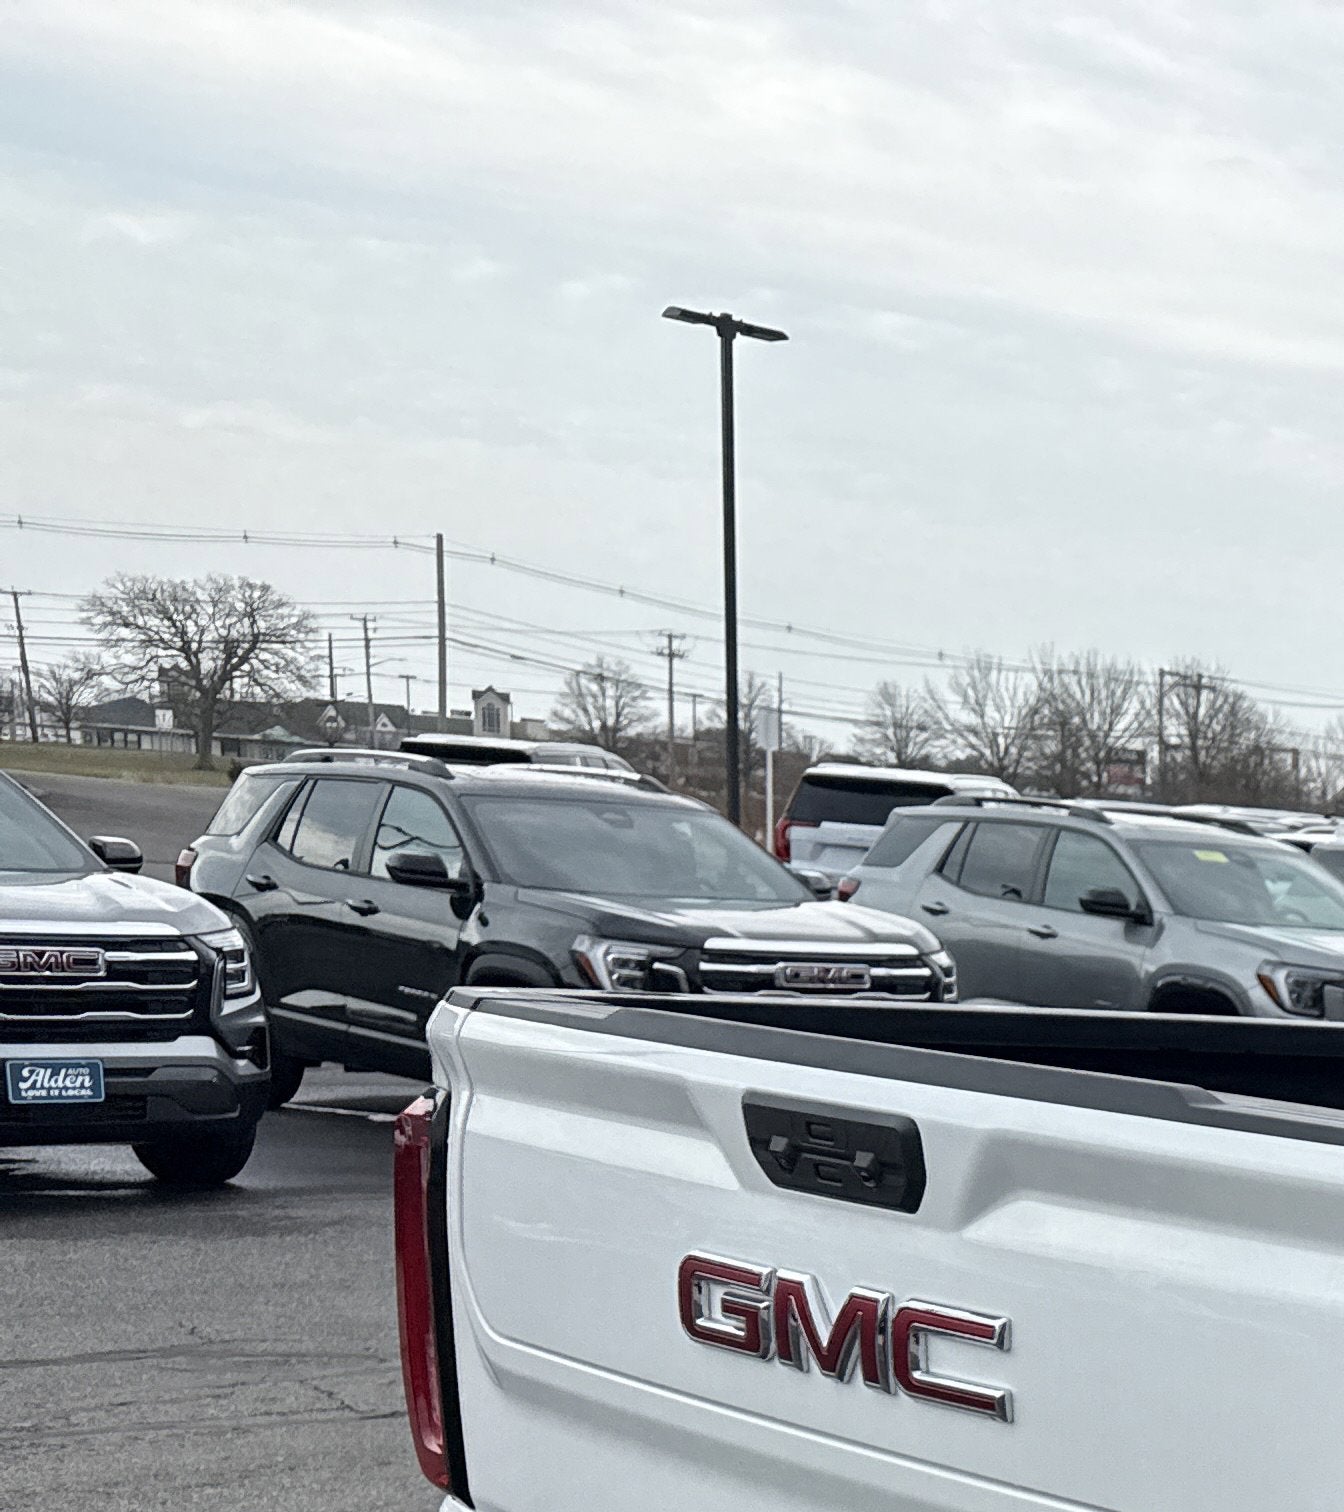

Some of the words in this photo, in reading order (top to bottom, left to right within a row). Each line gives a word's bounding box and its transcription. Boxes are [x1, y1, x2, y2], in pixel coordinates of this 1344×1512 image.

[18, 1066, 93, 1089] Alden
[21, 1088, 47, 1098] LOVE
[62, 1087, 93, 1097] LOCAL
[677, 1249, 1014, 1424] GMC
